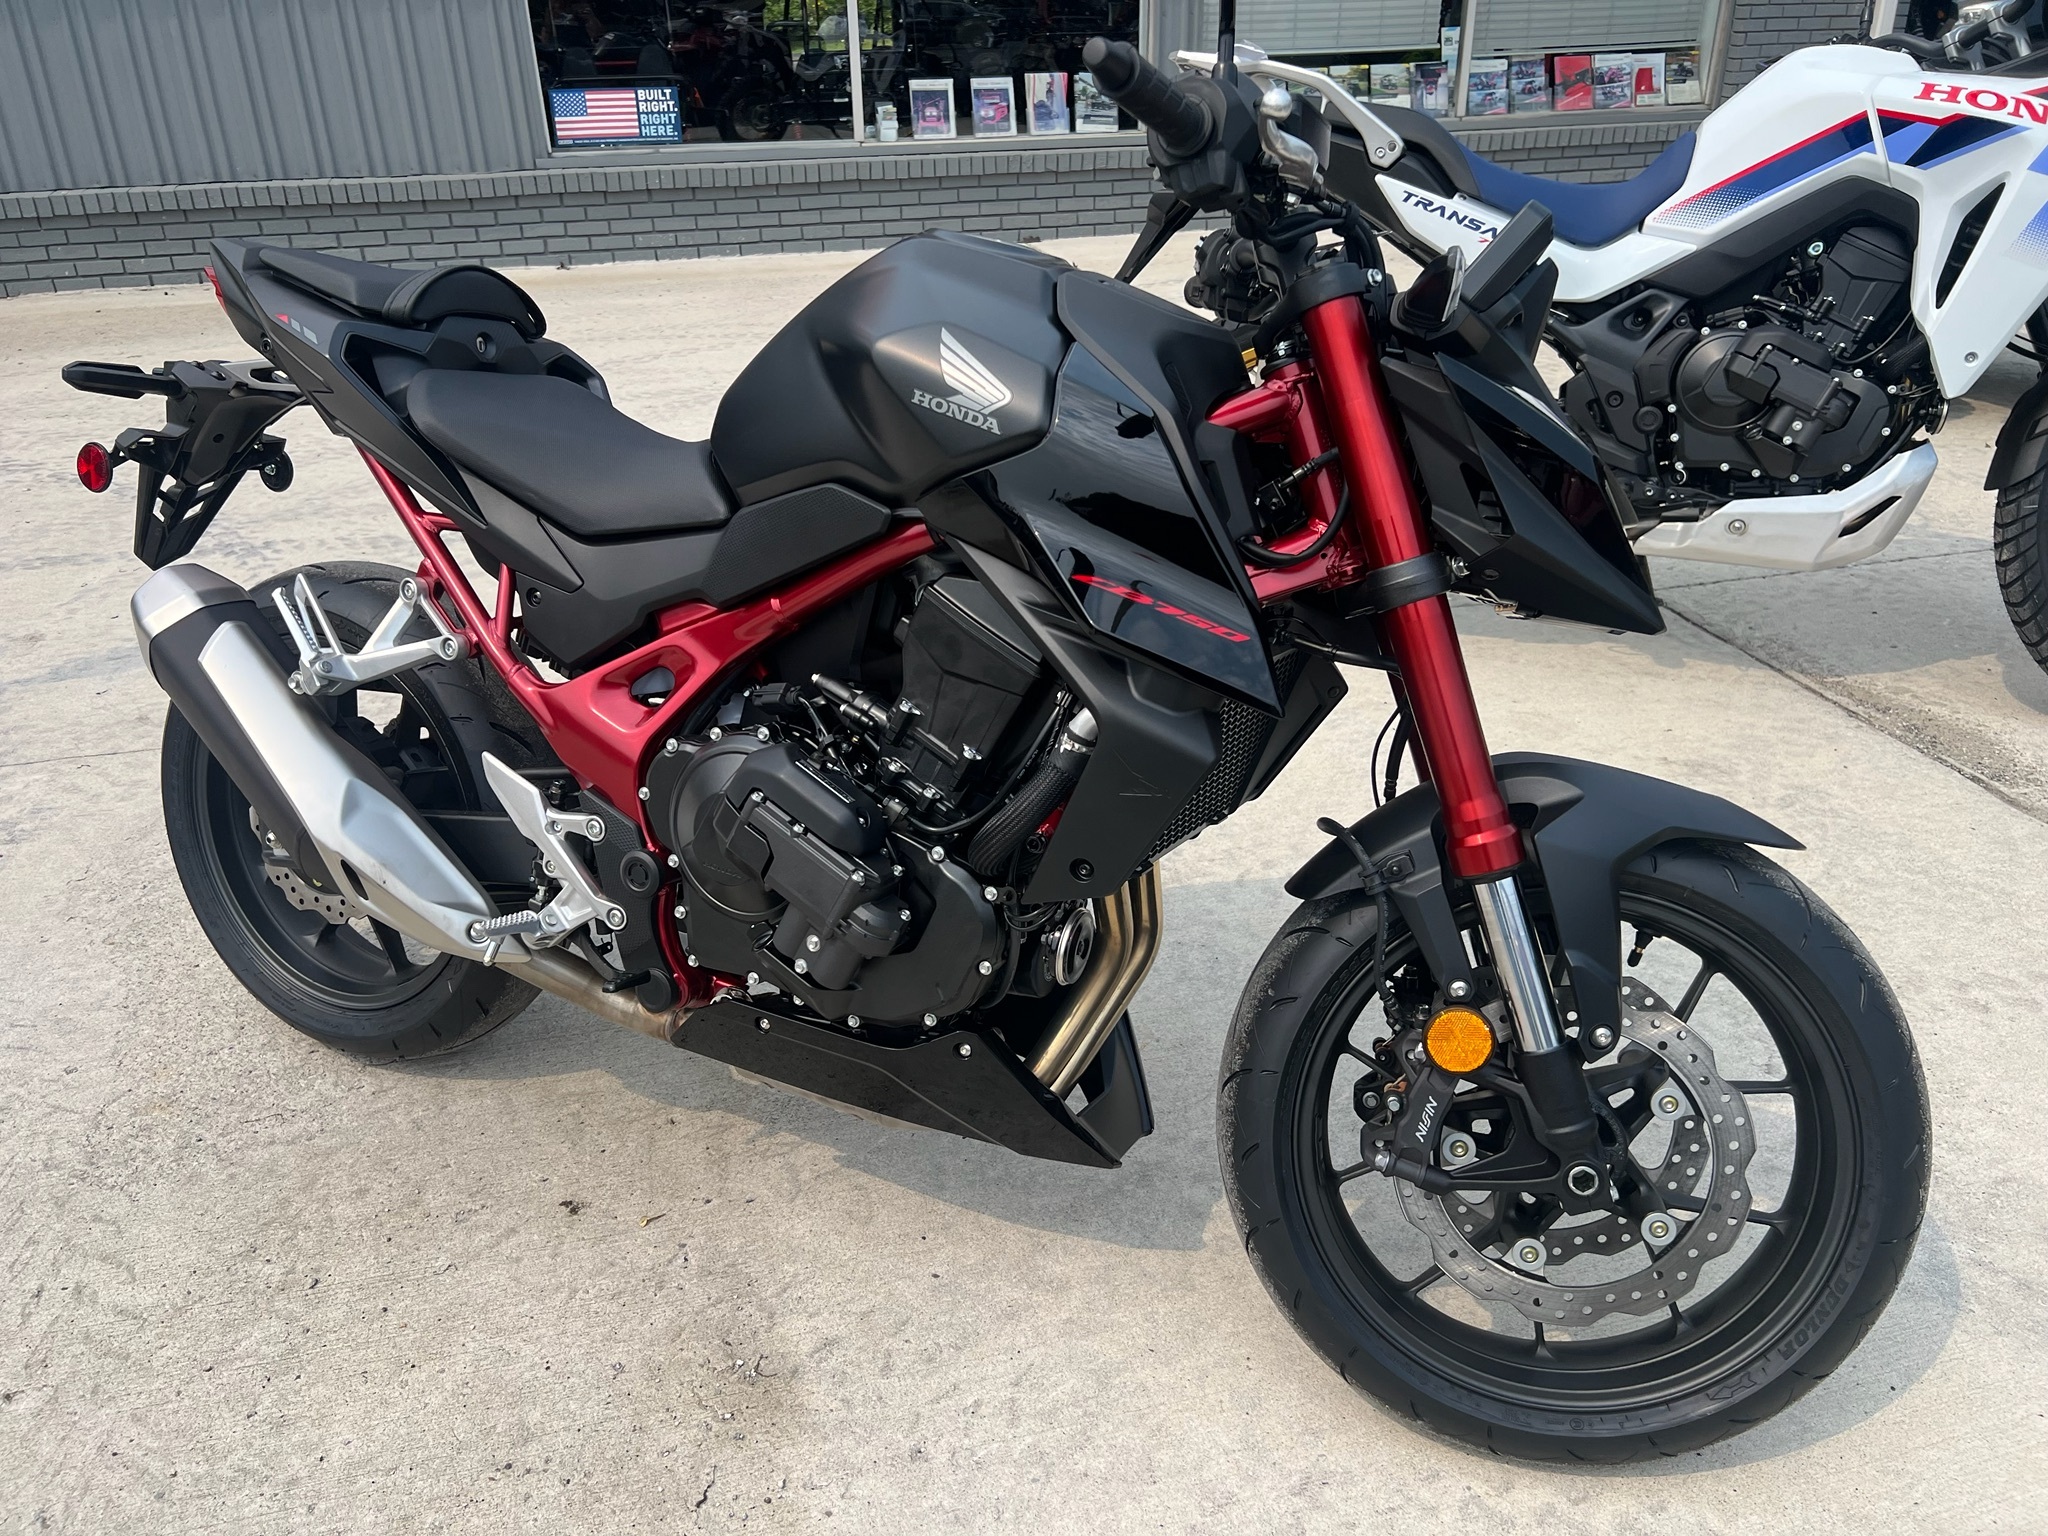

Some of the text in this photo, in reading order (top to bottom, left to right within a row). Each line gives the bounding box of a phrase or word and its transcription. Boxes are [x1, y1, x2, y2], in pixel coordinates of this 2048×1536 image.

[637, 89, 671, 100] BUILT
[639, 101, 678, 112] RIGHT.
[640, 113, 677, 125] RIGHT
[641, 125, 678, 136] HERE.
[911, 388, 1001, 435] HONDA
